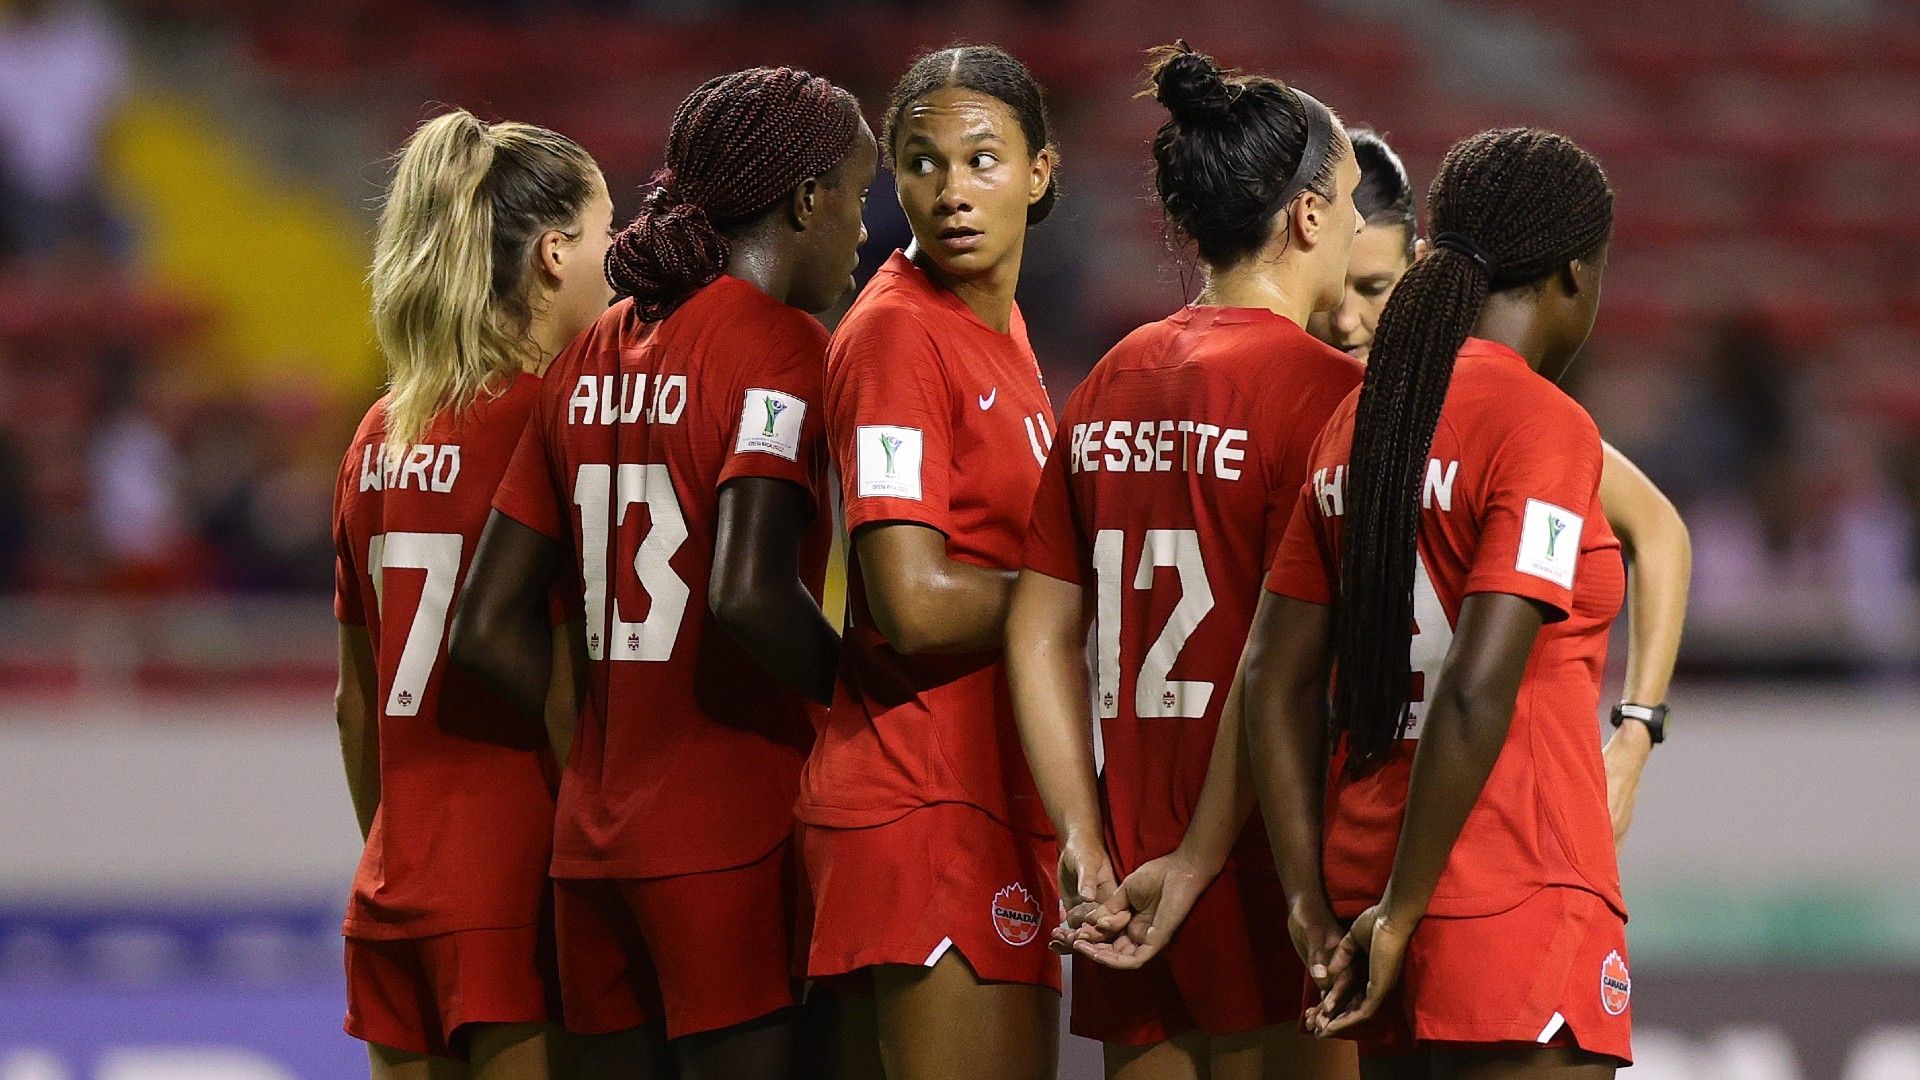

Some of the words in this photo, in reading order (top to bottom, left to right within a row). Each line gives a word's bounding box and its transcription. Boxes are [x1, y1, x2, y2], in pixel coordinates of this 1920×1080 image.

[359, 443, 461, 493] WARD
[1071, 420, 1248, 481] BESSETTE
[574, 464, 690, 661] 13
[1093, 529, 1215, 718] 12
[995, 908, 1039, 924] CANADA
[1603, 976, 1628, 992] CANADA
